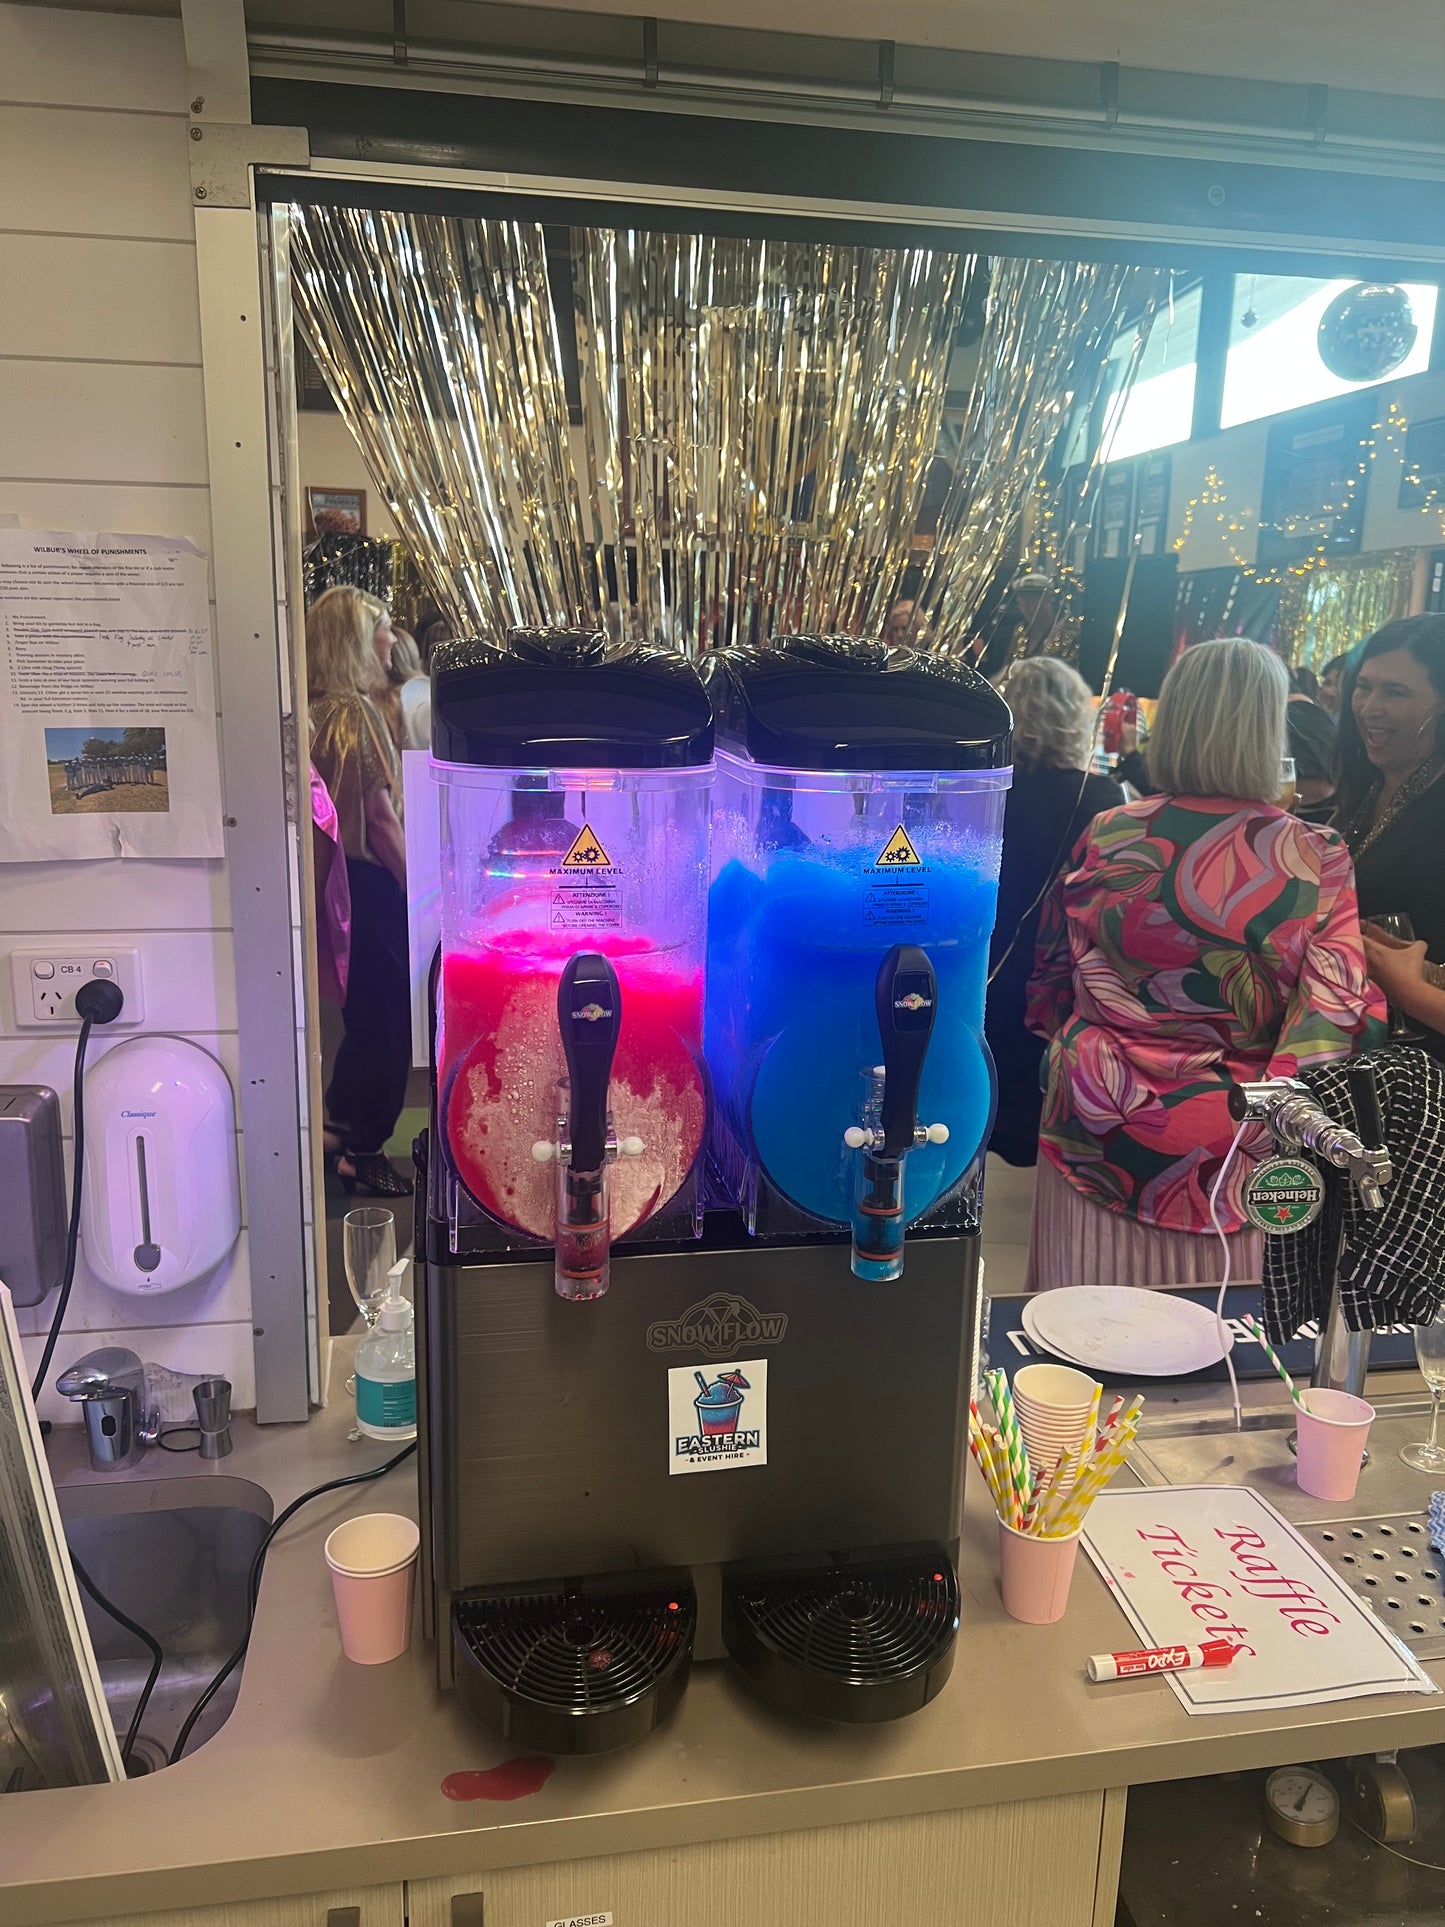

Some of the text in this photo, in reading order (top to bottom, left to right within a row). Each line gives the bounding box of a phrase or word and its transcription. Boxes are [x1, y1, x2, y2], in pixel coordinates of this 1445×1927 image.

[1252, 1190, 1318, 1202] Heineken
[678, 1432, 758, 1453] EASTERN
[1136, 1524, 1256, 1656] Tickets
[1214, 1525, 1341, 1638] Raffle
